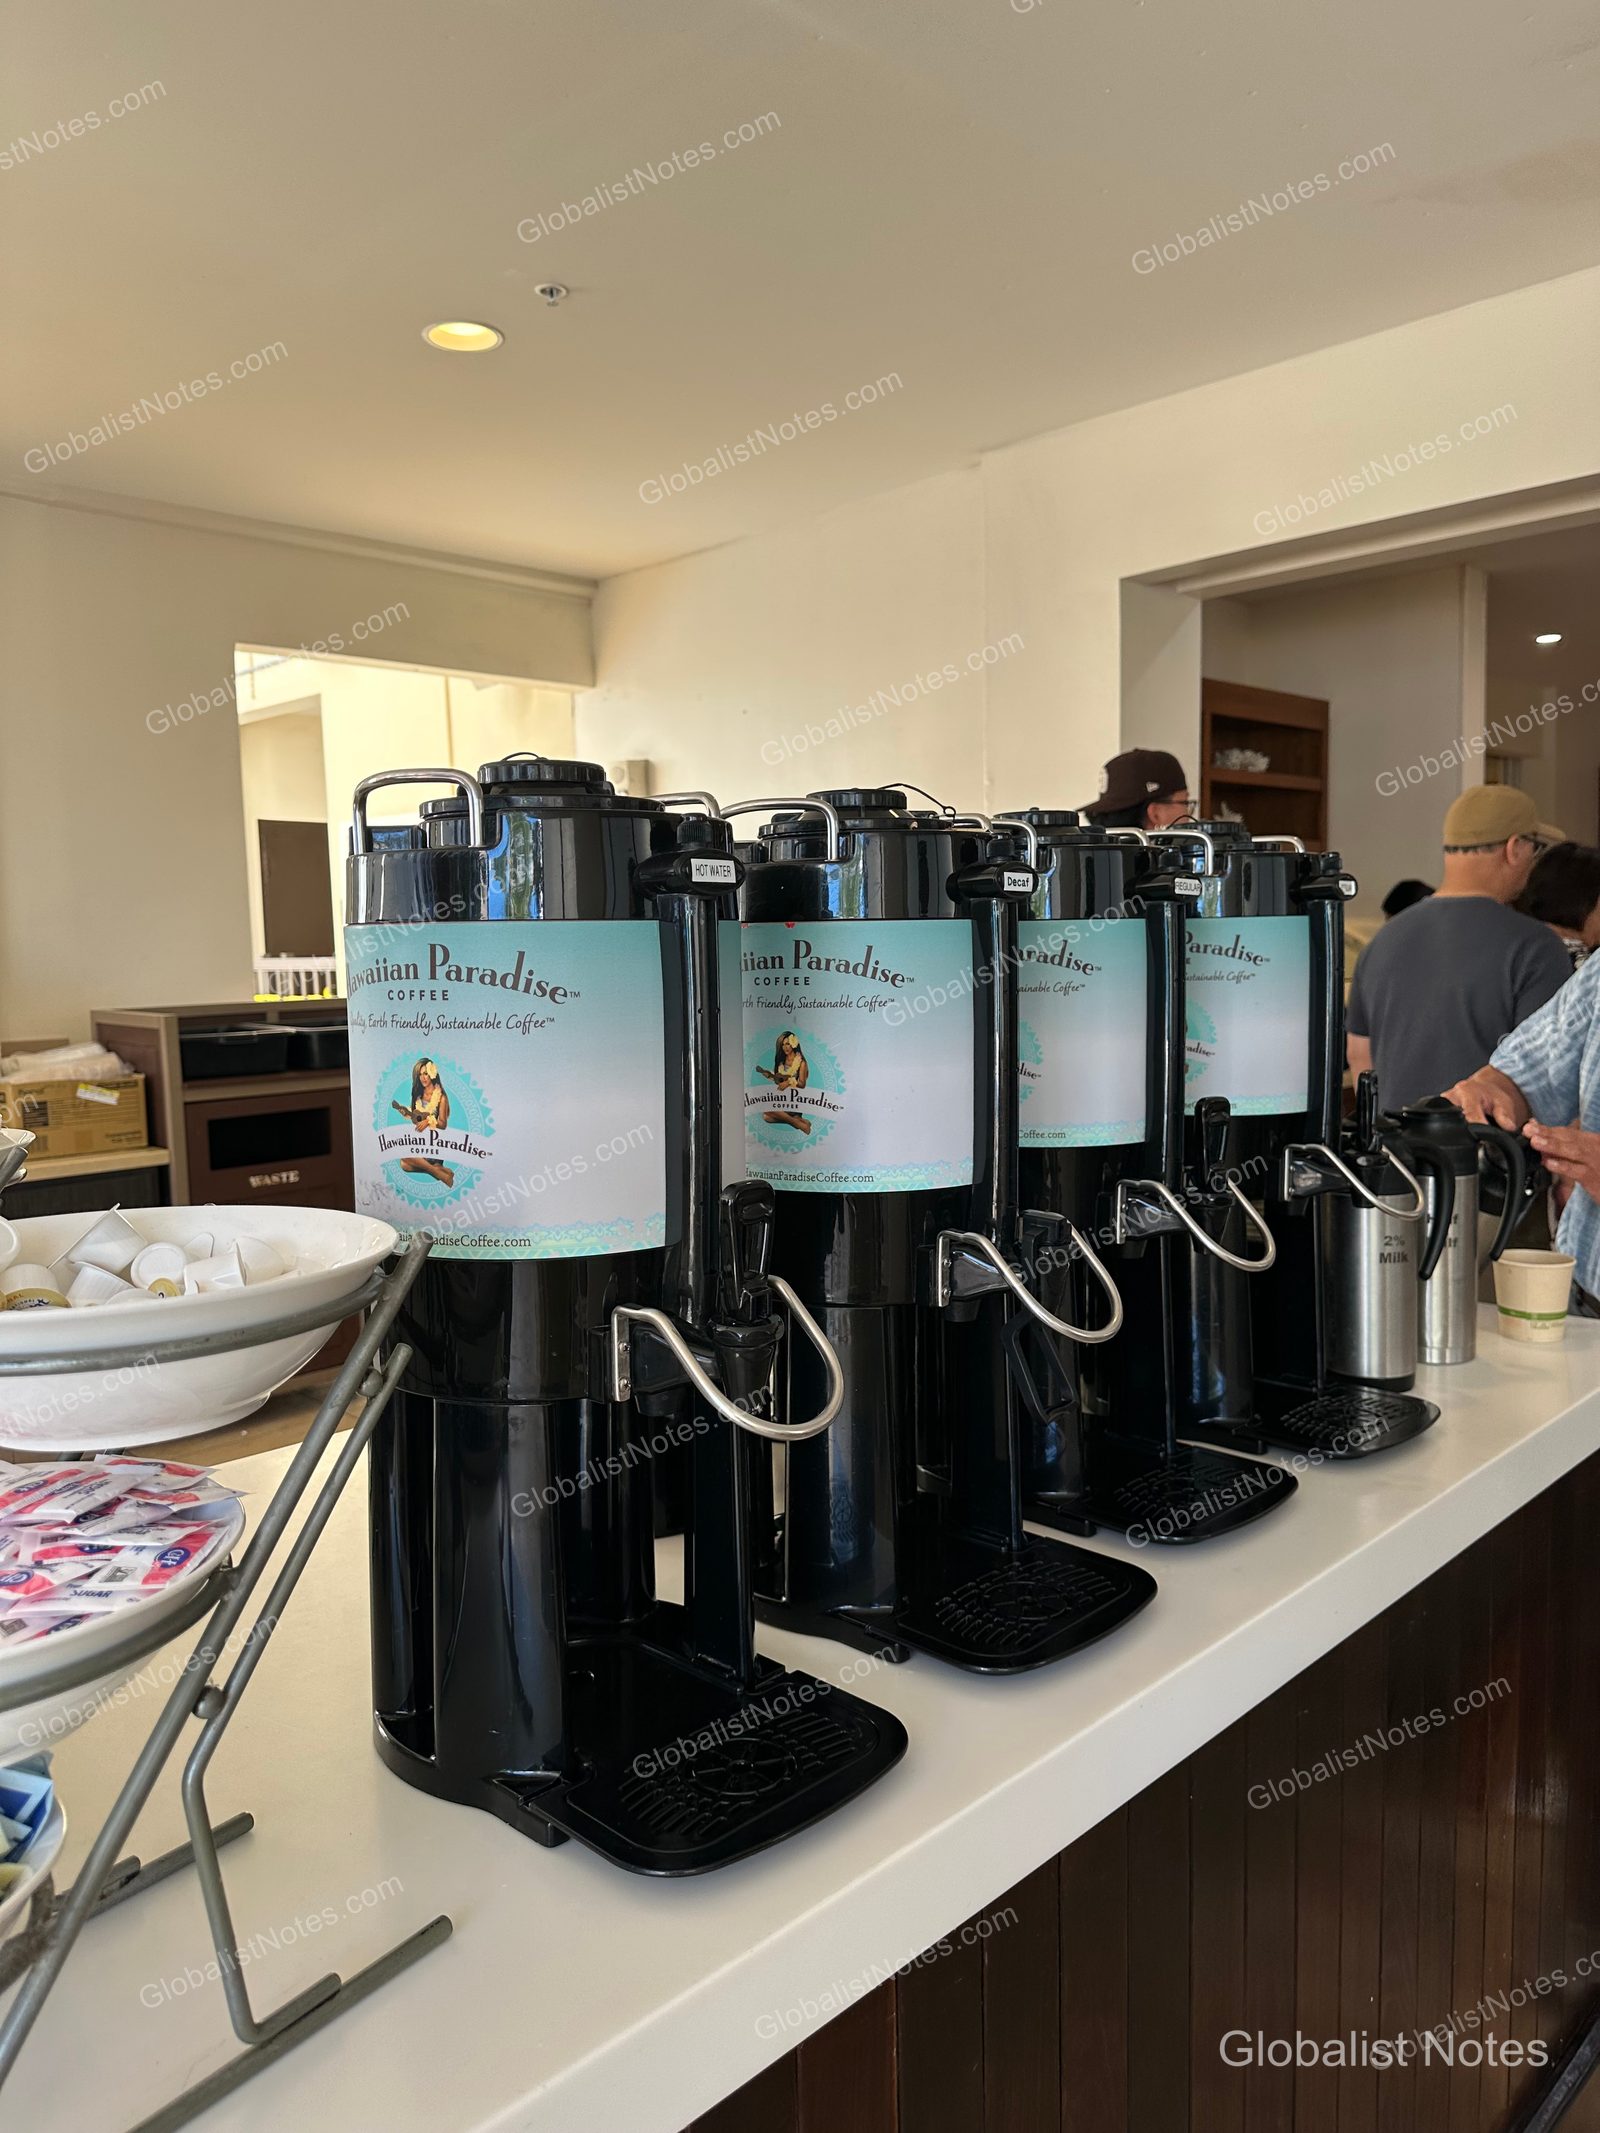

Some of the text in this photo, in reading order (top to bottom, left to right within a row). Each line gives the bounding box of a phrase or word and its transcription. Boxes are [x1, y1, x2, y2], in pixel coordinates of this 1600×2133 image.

[695, 864, 732, 877] HOT WATER
[1007, 876, 1030, 887] Decaf
[742, 952, 784, 972] iian
[754, 976, 811, 986] COFFEE
[1018, 981, 1051, 993] ainable
[387, 989, 449, 1001] COFFEE
[757, 995, 796, 1014] Friendly,
[797, 994, 853, 1009] Sustainable
[368, 1011, 388, 1029] Earth
[390, 1011, 433, 1036] Friendly,
[435, 1012, 502, 1030] Sustainable
[378, 1134, 426, 1152] Hawaiian
[410, 1147, 439, 1155] COFFEE
[249, 1170, 300, 1188] WASTE
[1383, 1235, 1406, 1246] 2%
[1379, 1252, 1409, 1263] Milk
[70, 1590, 113, 1598] SUGAR
